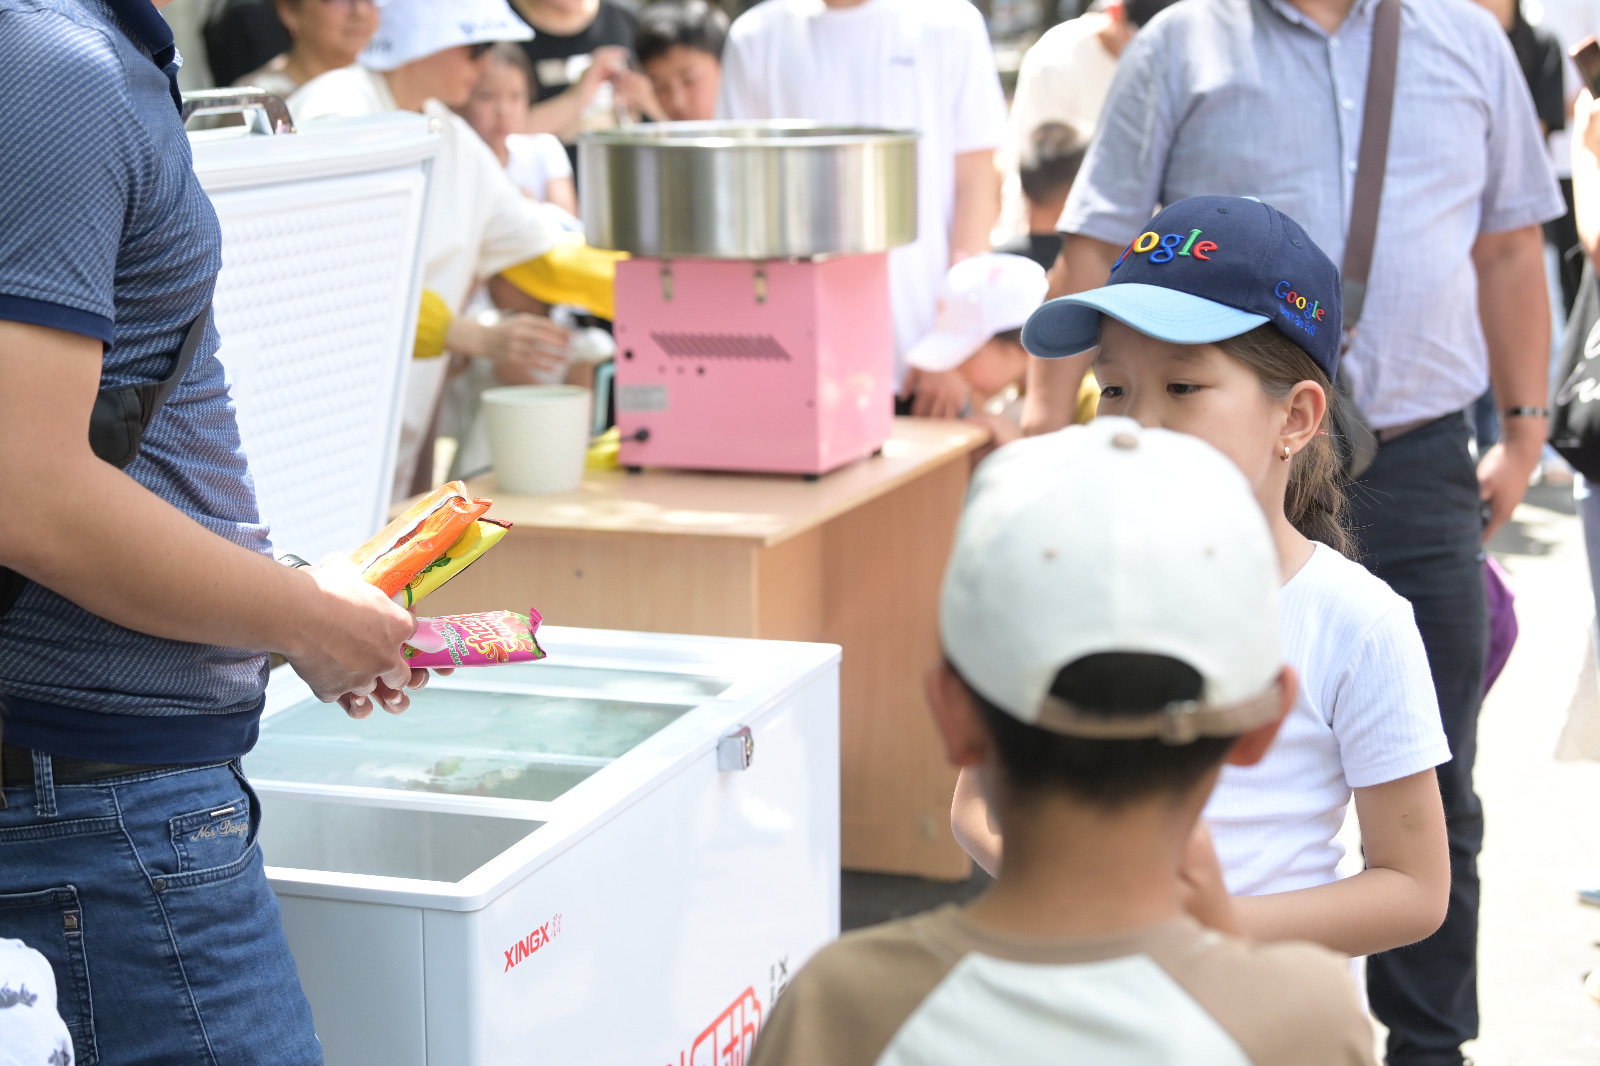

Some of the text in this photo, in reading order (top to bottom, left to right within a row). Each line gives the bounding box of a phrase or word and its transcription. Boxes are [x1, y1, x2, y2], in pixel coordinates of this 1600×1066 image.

[1111, 228, 1218, 272] ogle
[1275, 280, 1325, 322] Google
[504, 921, 550, 973] XINGX
